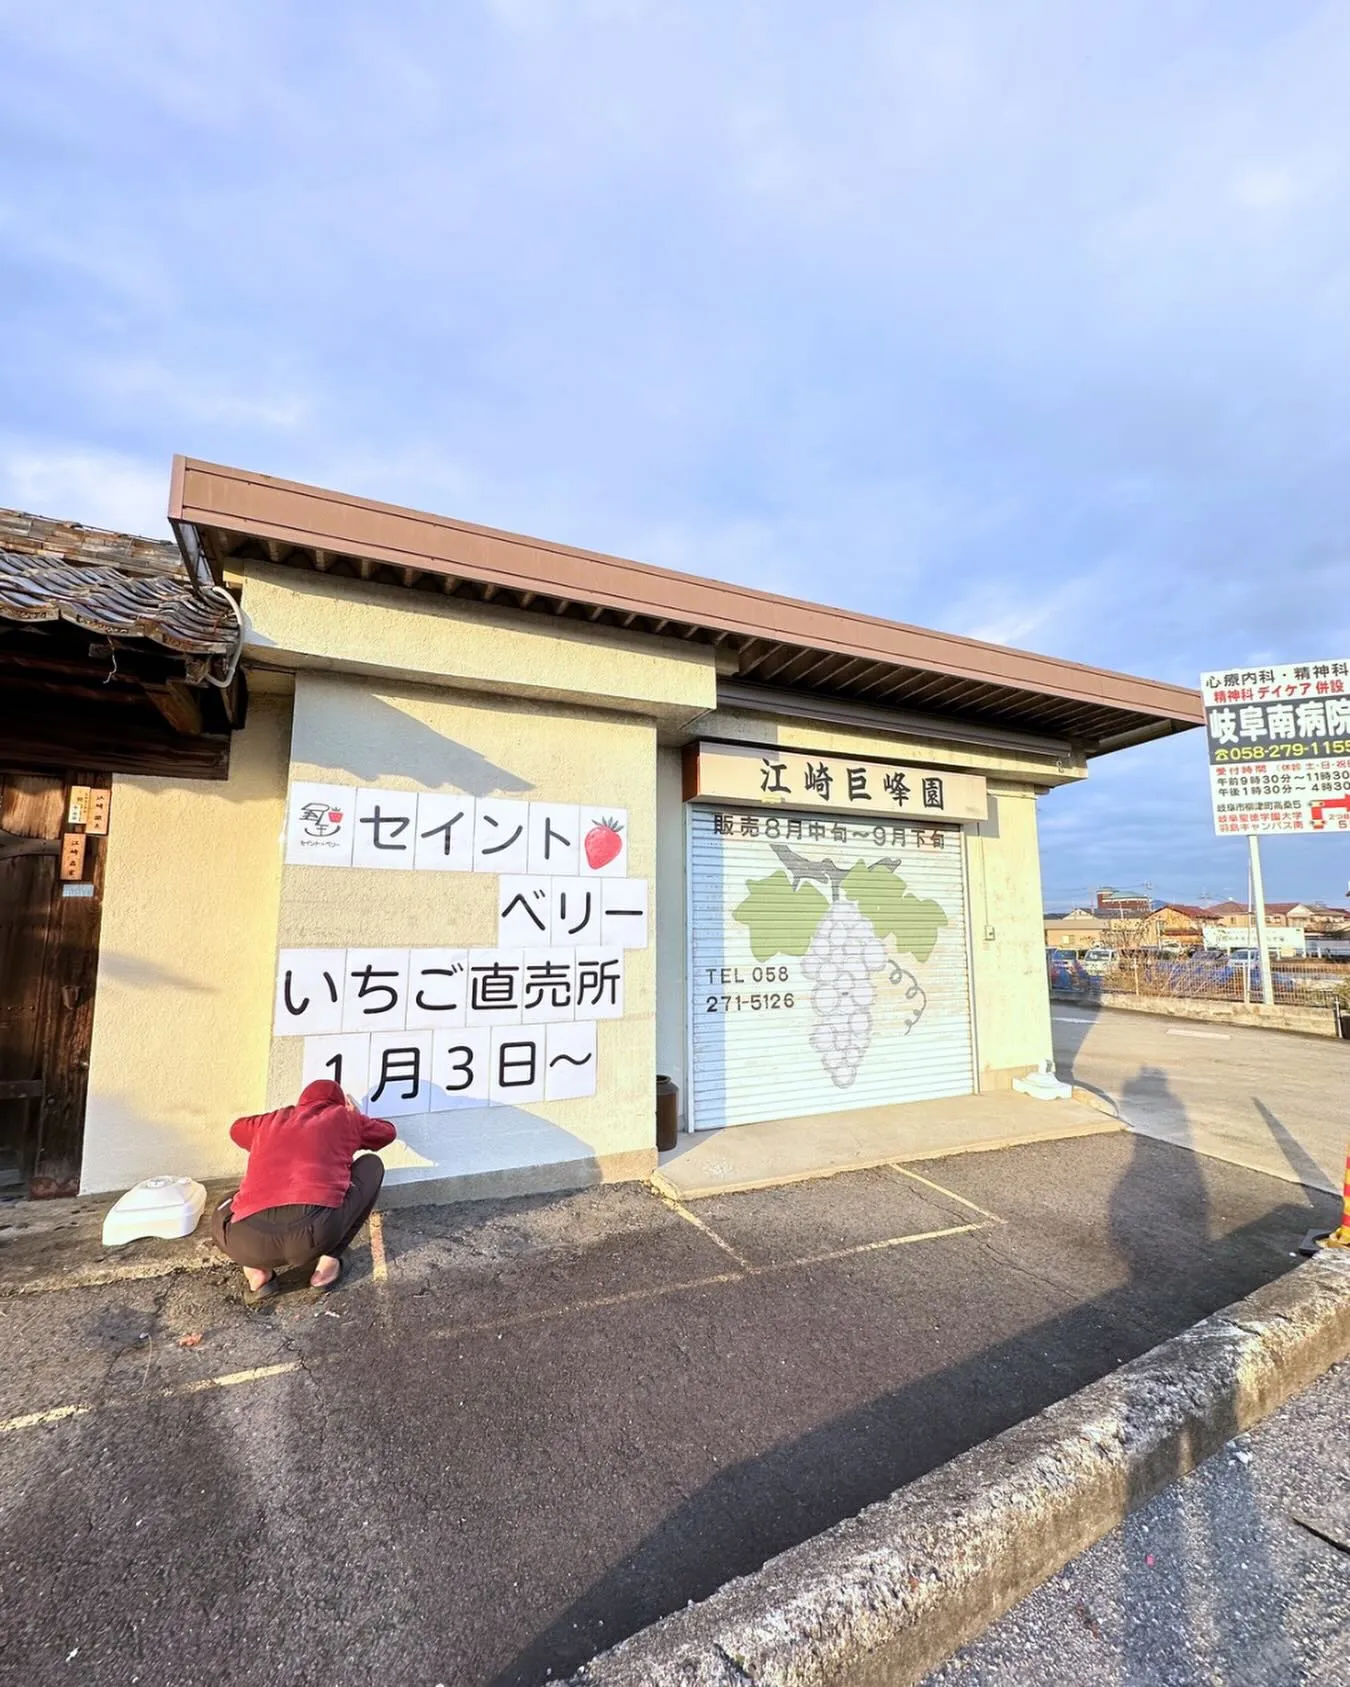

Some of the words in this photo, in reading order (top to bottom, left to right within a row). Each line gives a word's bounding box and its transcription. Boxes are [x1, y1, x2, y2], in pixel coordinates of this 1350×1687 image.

[1209, 698, 1350, 744] 岐阜南病院
[760, 758, 944, 810] 江崎巨峰園
[359, 805, 571, 859] セイント
[501, 889, 643, 935] ベリー
[284, 958, 621, 1016] いちご直売所
[705, 967, 745, 984] TEL
[752, 966, 789, 982] 058
[706, 993, 795, 1013] 271-5126
